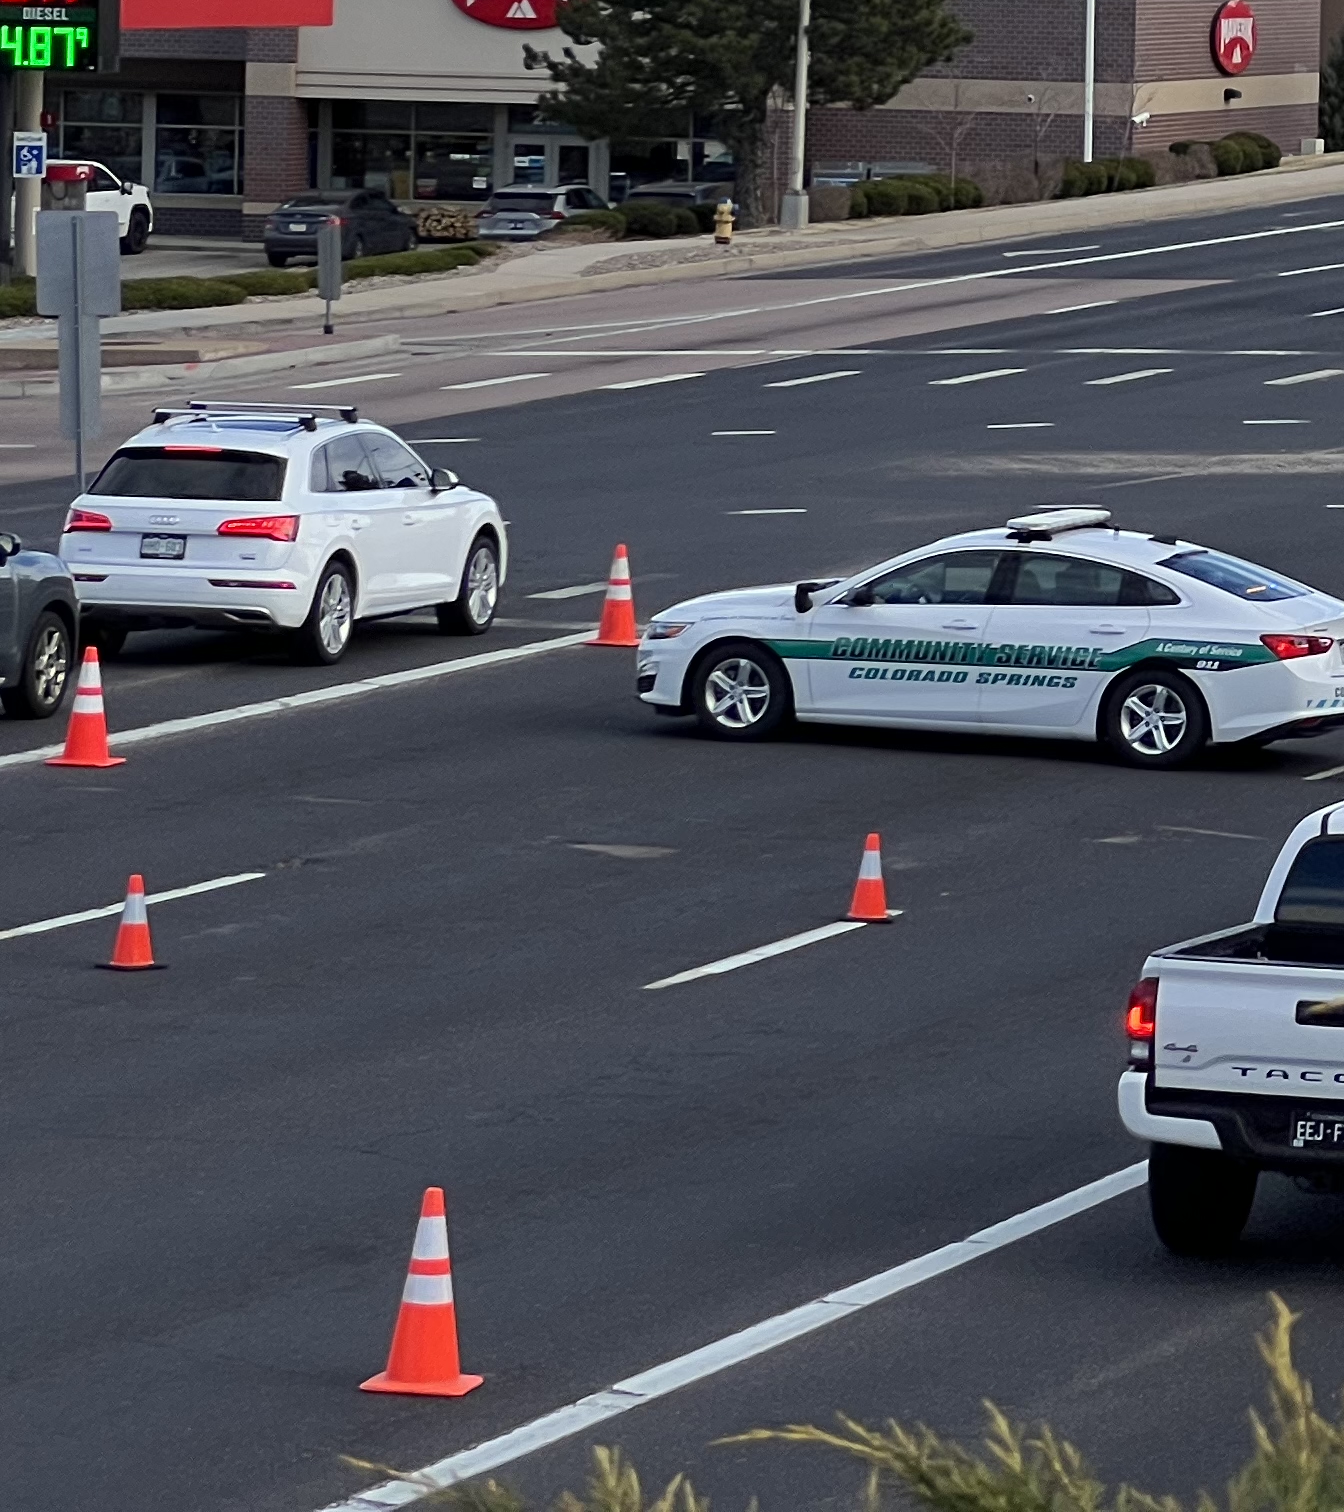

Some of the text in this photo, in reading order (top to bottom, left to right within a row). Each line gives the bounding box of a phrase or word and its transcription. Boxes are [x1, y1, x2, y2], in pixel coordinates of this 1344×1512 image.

[22, 7, 69, 20] DIESEL
[831, 637, 1103, 670] COMMUNITY SERVICE
[848, 667, 1078, 689] COLORADO SPRINGS
